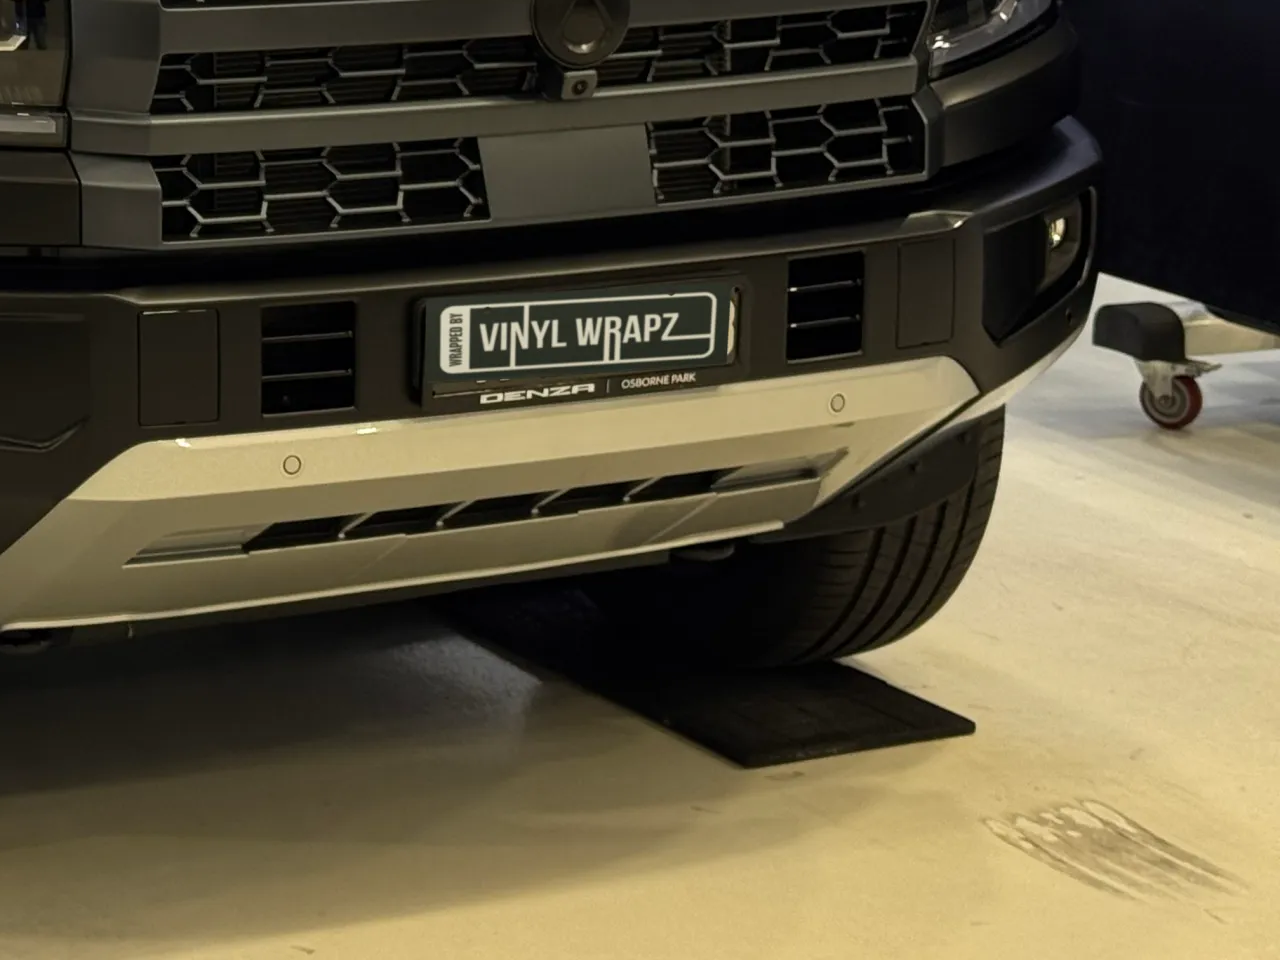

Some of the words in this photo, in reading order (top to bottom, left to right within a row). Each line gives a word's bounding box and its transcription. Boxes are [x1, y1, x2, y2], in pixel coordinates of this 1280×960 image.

[448, 313, 463, 324] BY
[448, 326, 463, 368] WRAPPED
[478, 309, 568, 362] VINYL
[575, 312, 692, 358] WRAPZ
[620, 374, 670, 390] OSBORNE
[671, 371, 697, 383] PARK
[479, 382, 596, 405] DENZA
